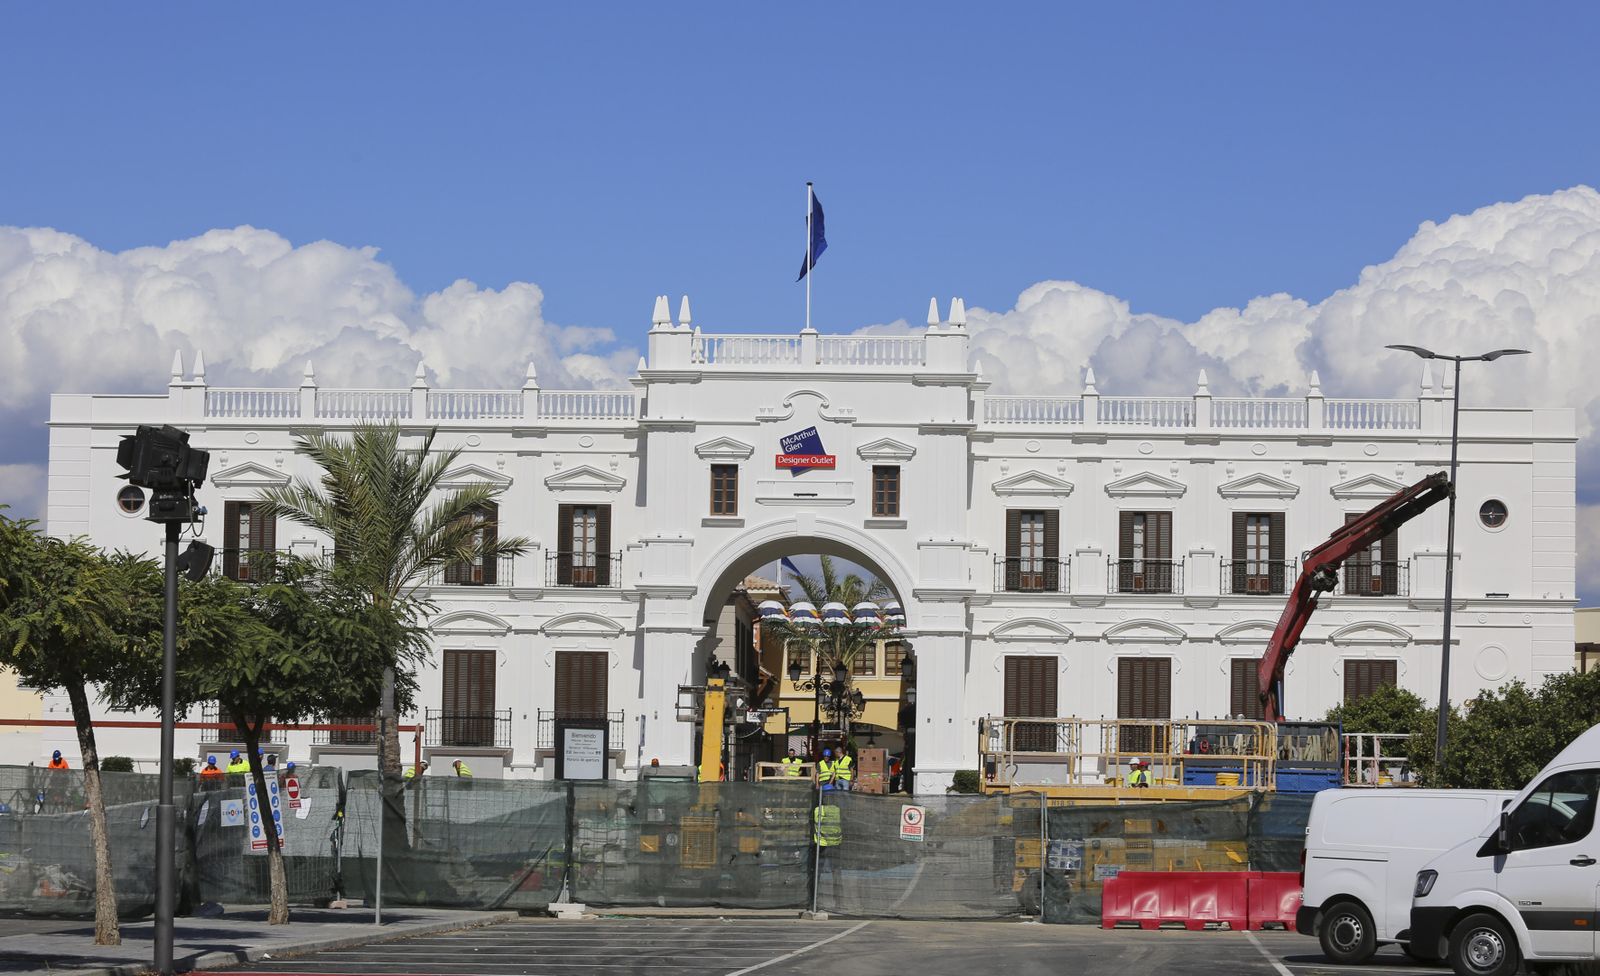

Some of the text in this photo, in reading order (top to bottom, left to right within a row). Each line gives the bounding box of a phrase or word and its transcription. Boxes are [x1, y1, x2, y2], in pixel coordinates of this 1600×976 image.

[782, 429, 817, 446] McArthur
[785, 442, 803, 453] Glen
[778, 456, 833, 465] Designer Outlet
